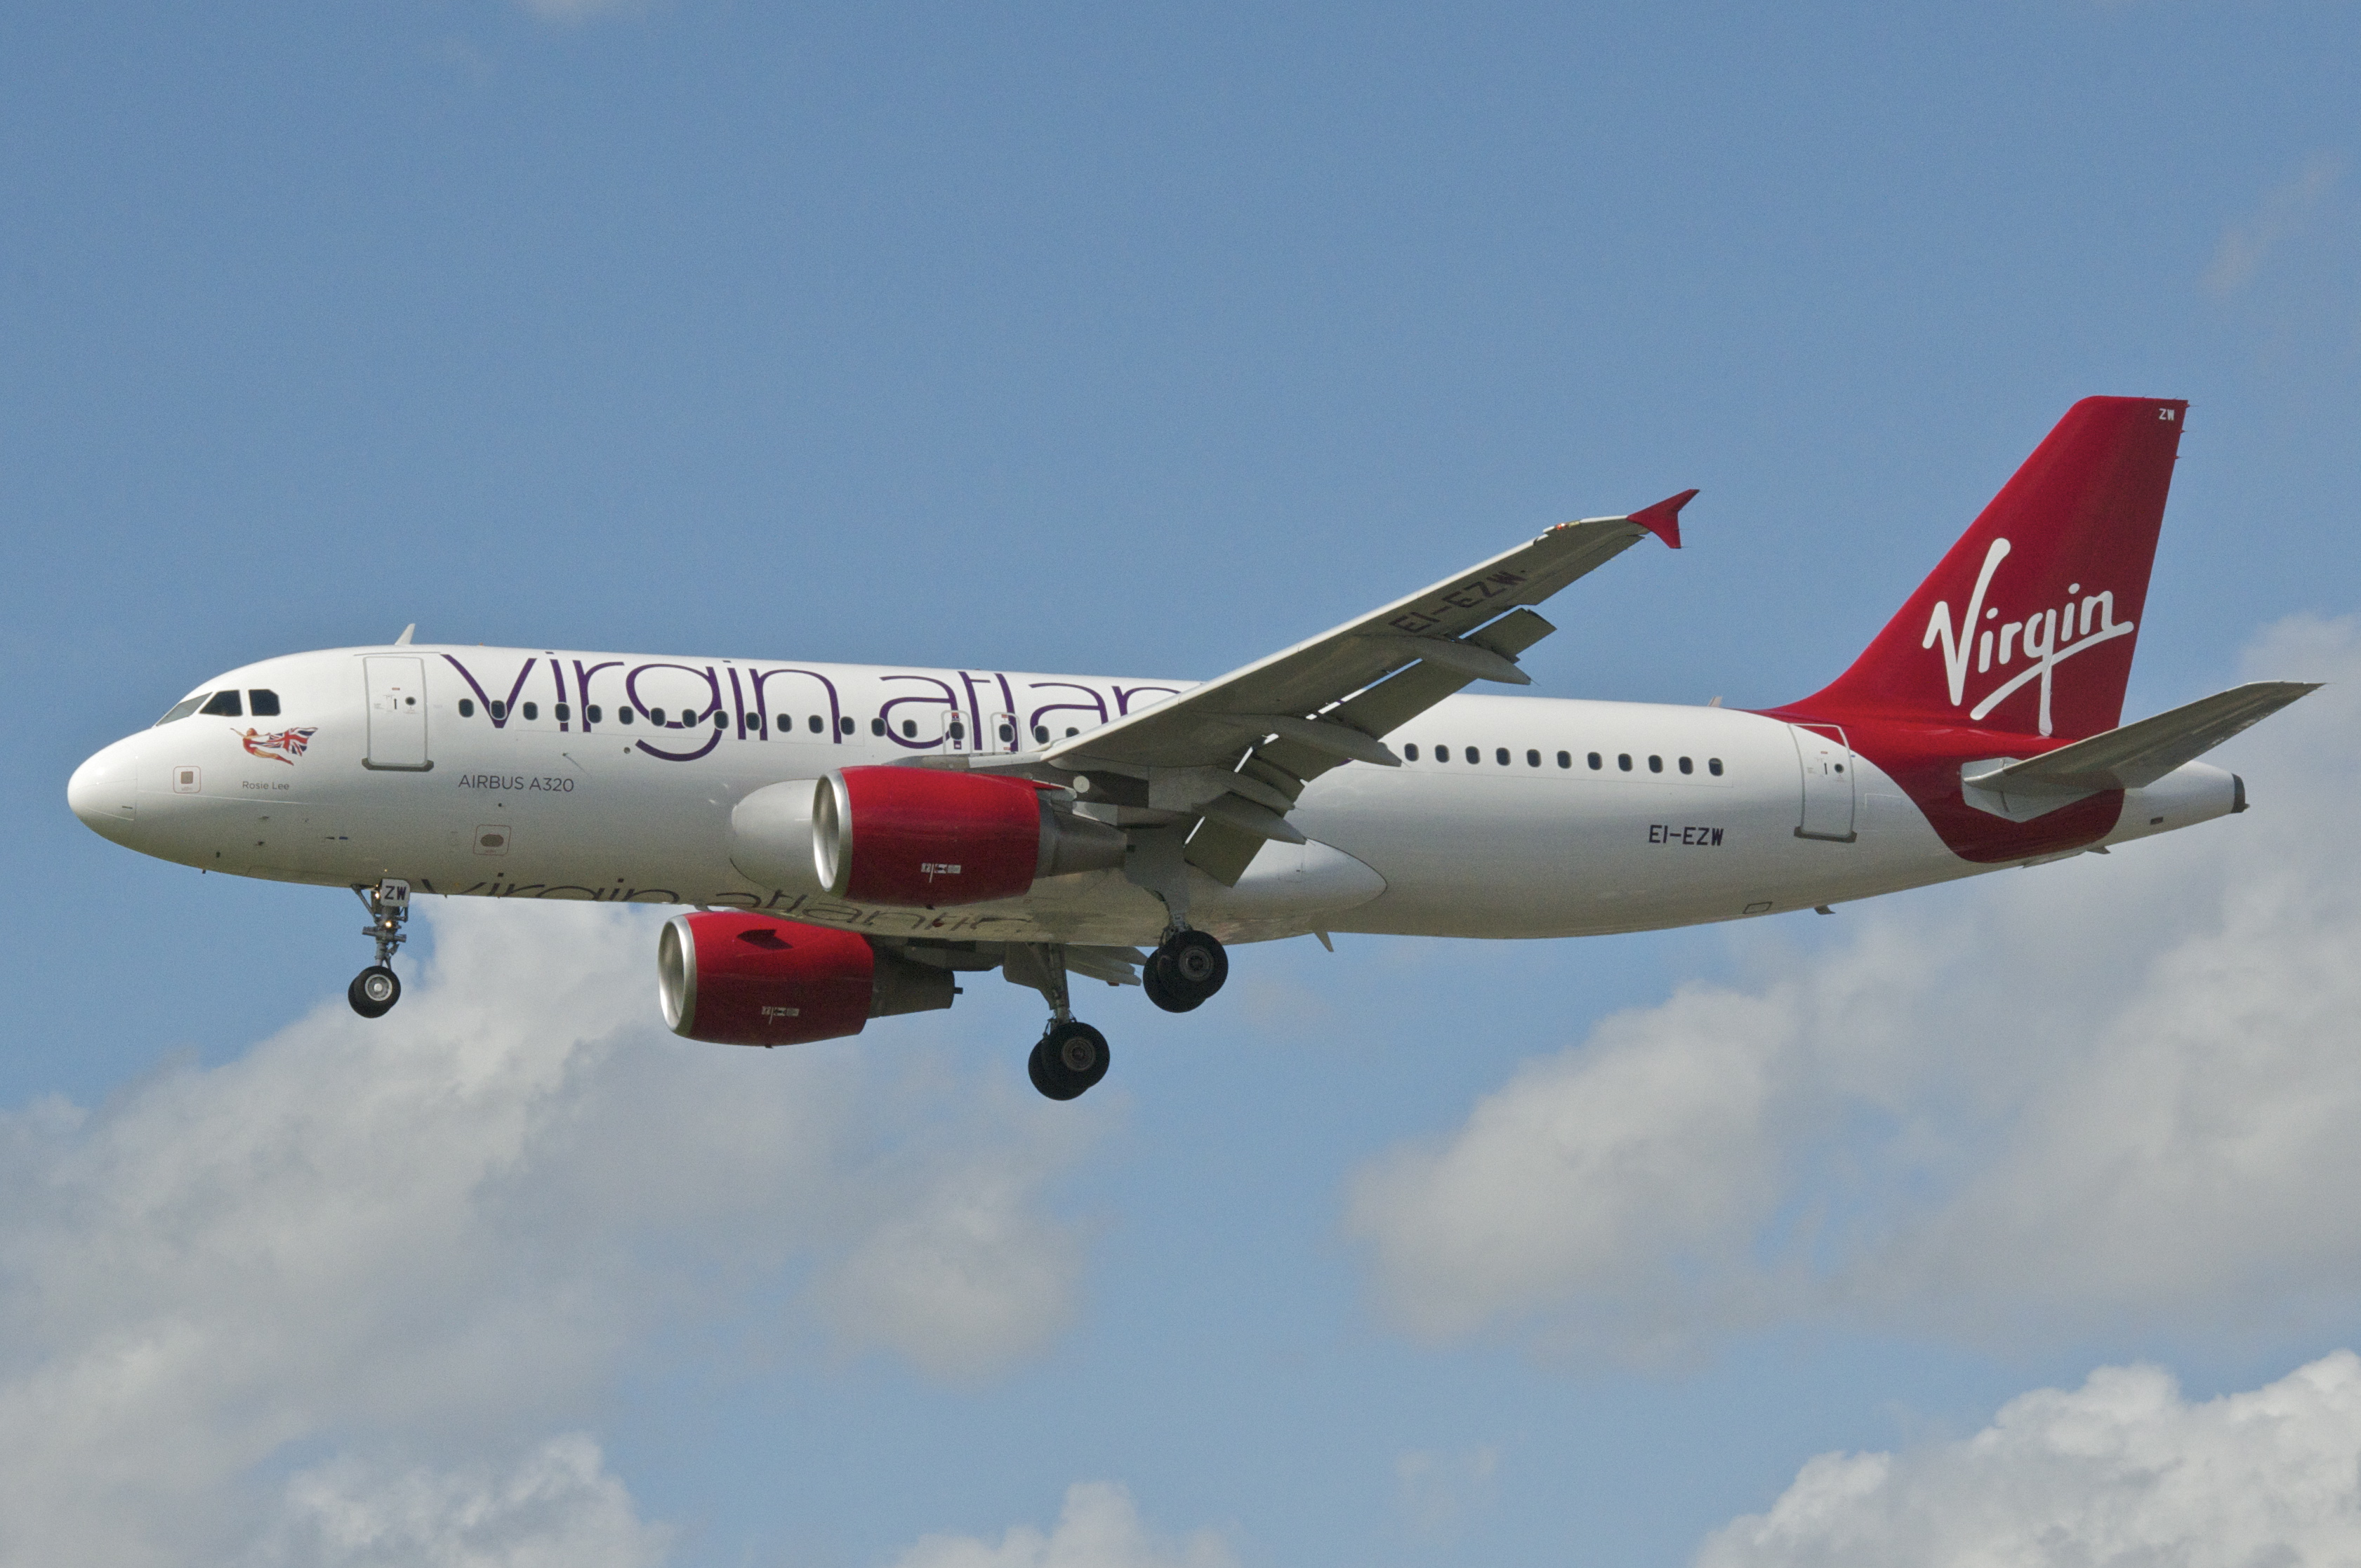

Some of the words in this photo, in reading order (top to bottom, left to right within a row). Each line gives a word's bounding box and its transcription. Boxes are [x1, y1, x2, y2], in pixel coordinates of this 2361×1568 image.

[2159, 408, 2176, 421] ZW
[1389, 569, 1526, 632] EI-EZW
[1922, 538, 2134, 736] Virgin
[440, 651, 842, 762] virgin
[879, 670, 1186, 750] atlan
[242, 780, 269, 790] Rosie
[272, 781, 289, 790] Lee
[458, 774, 524, 790] AIRBUS
[529, 777, 574, 792] A320
[1648, 824, 1724, 846] EI-EZW
[384, 885, 406, 901] ZW
